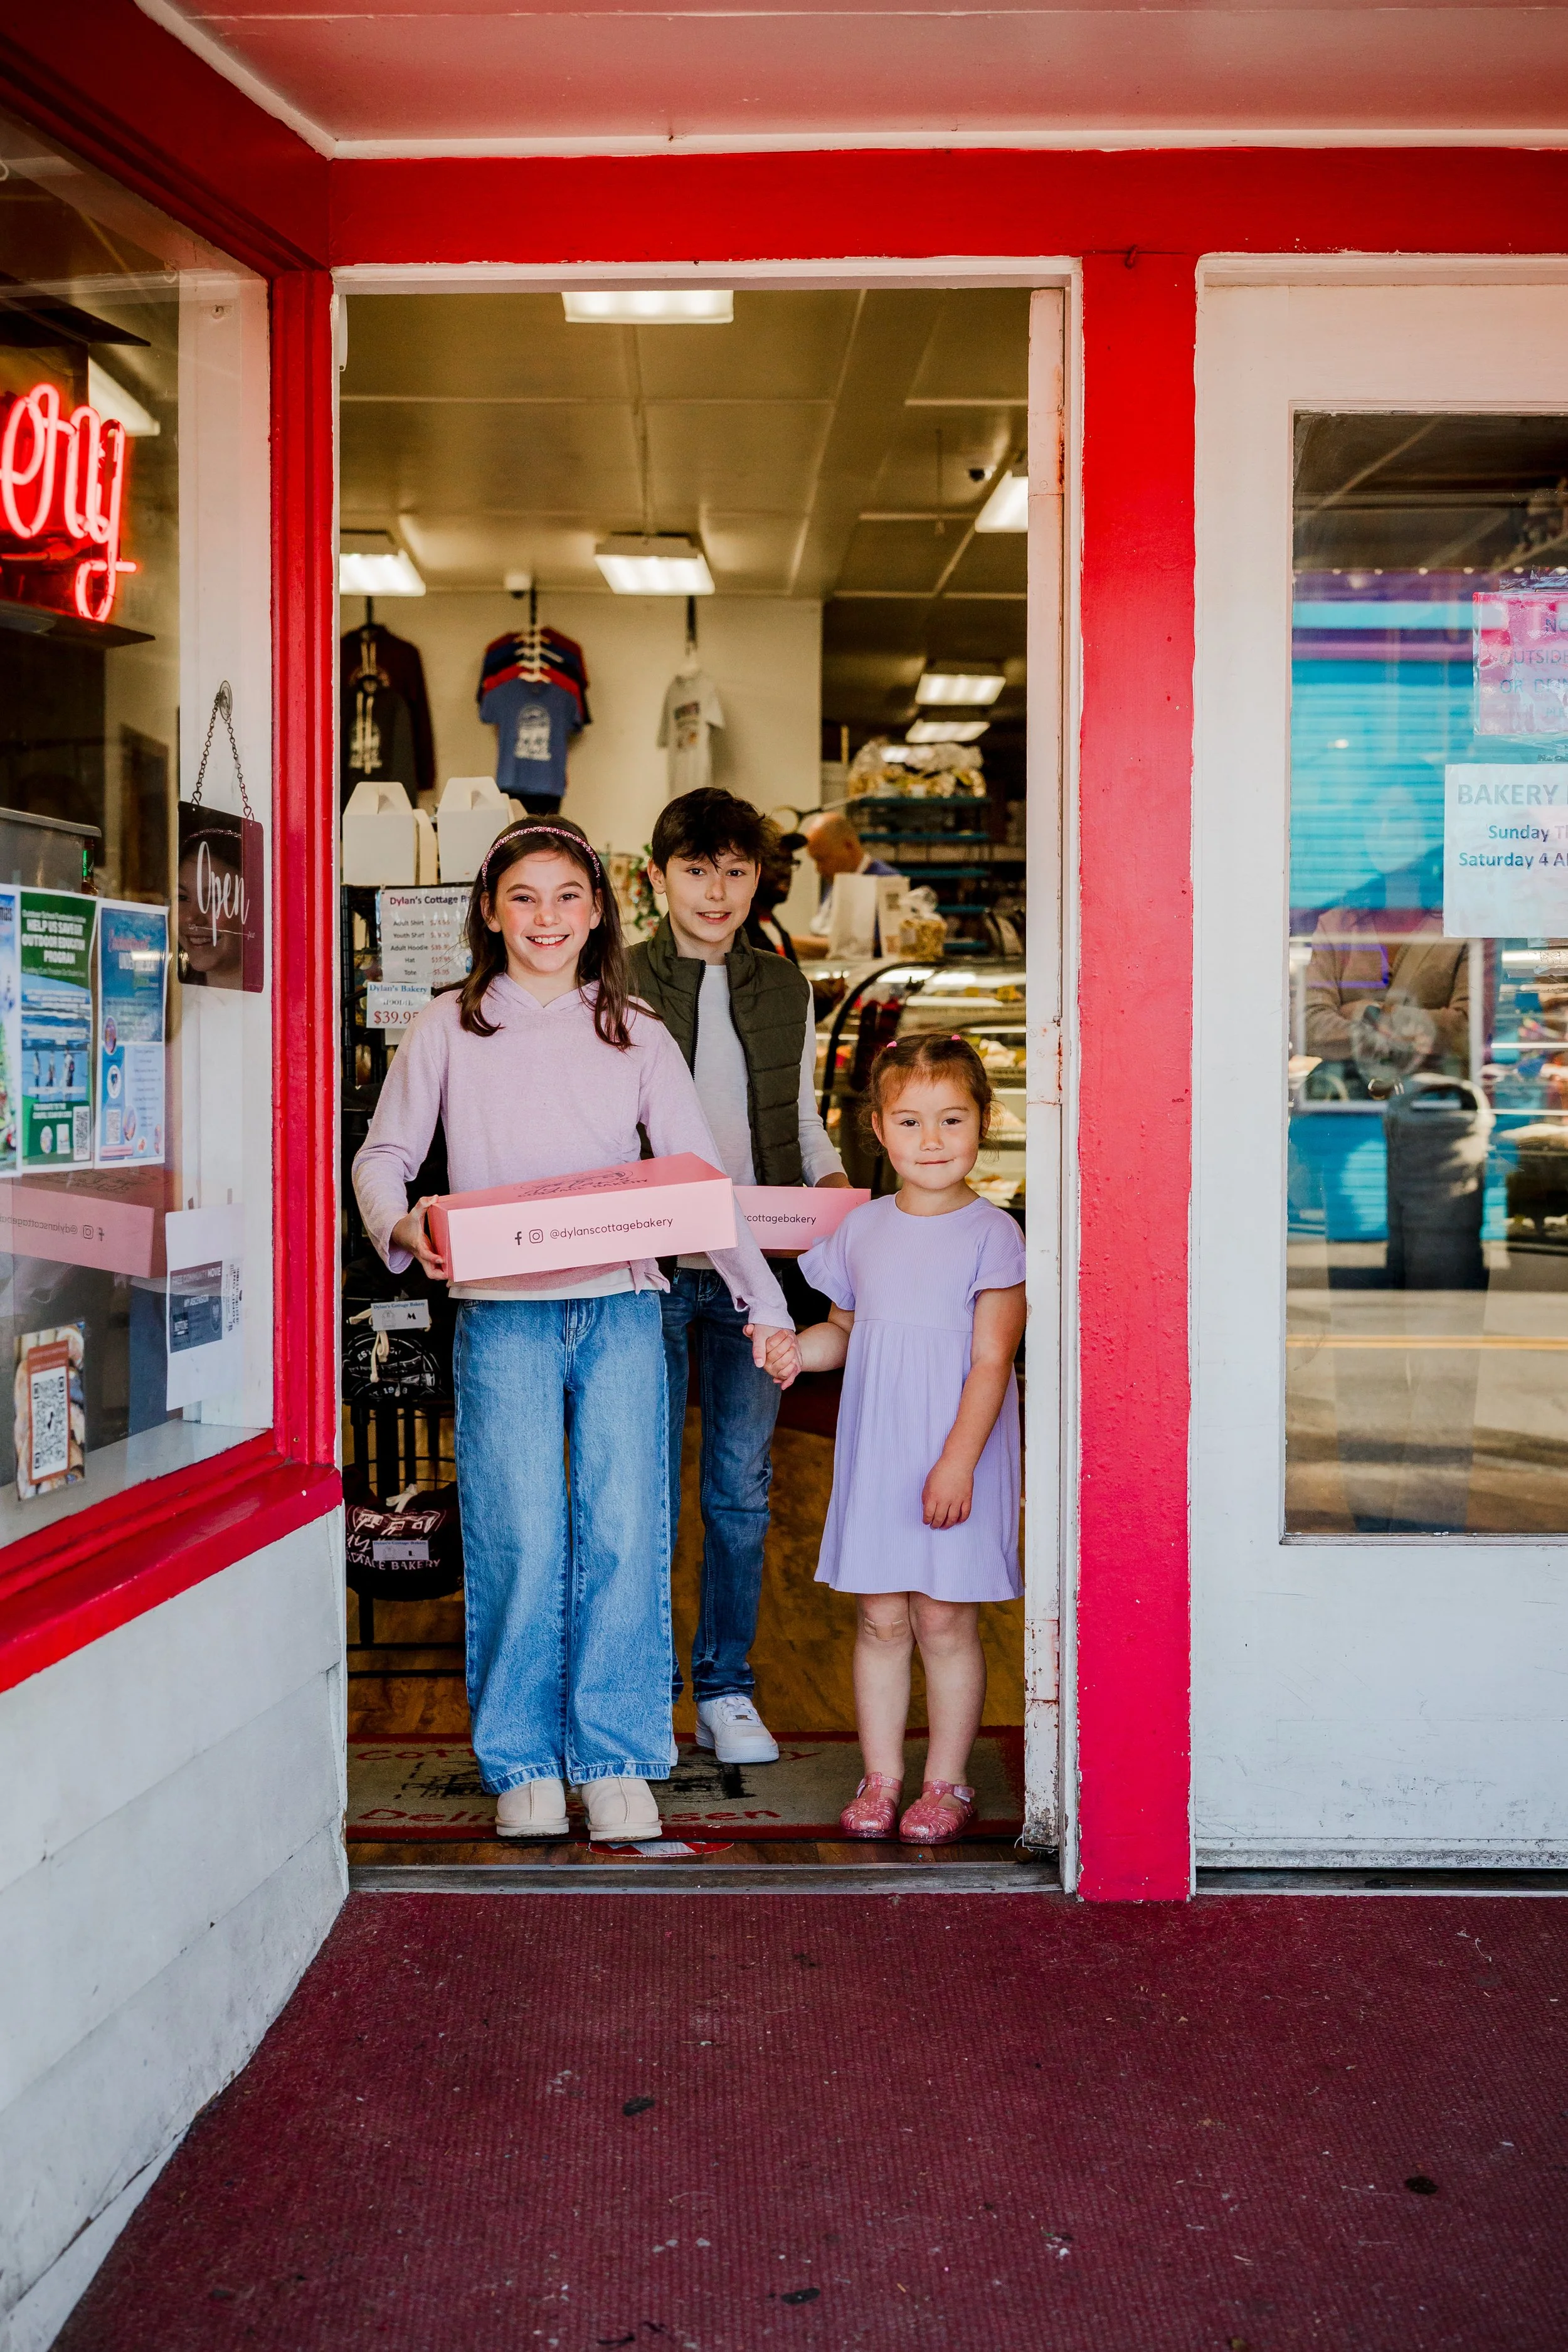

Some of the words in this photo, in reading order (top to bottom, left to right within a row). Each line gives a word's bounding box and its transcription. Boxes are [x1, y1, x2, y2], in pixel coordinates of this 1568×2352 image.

[1500, 679, 1524, 694] OR
[1458, 784, 1559, 805] BAKERY
[1488, 824, 1550, 842] Sunday
[1459, 852, 1535, 869] Saturday
[1539, 852, 1549, 866] 4
[1553, 852, 1568, 867] A
[197, 841, 250, 946] Open
[390, 896, 422, 906] Dylan's
[424, 896, 458, 905] Cottage
[369, 984, 398, 993] Dylan's
[401, 985, 428, 994] Bakery
[550, 1217, 674, 1239] @dylanscottagebakery
[208, 1267, 221, 1278] MOVIE
[406, 1312, 416, 1320] M
[391, 1559, 440, 1570] BAKERY
